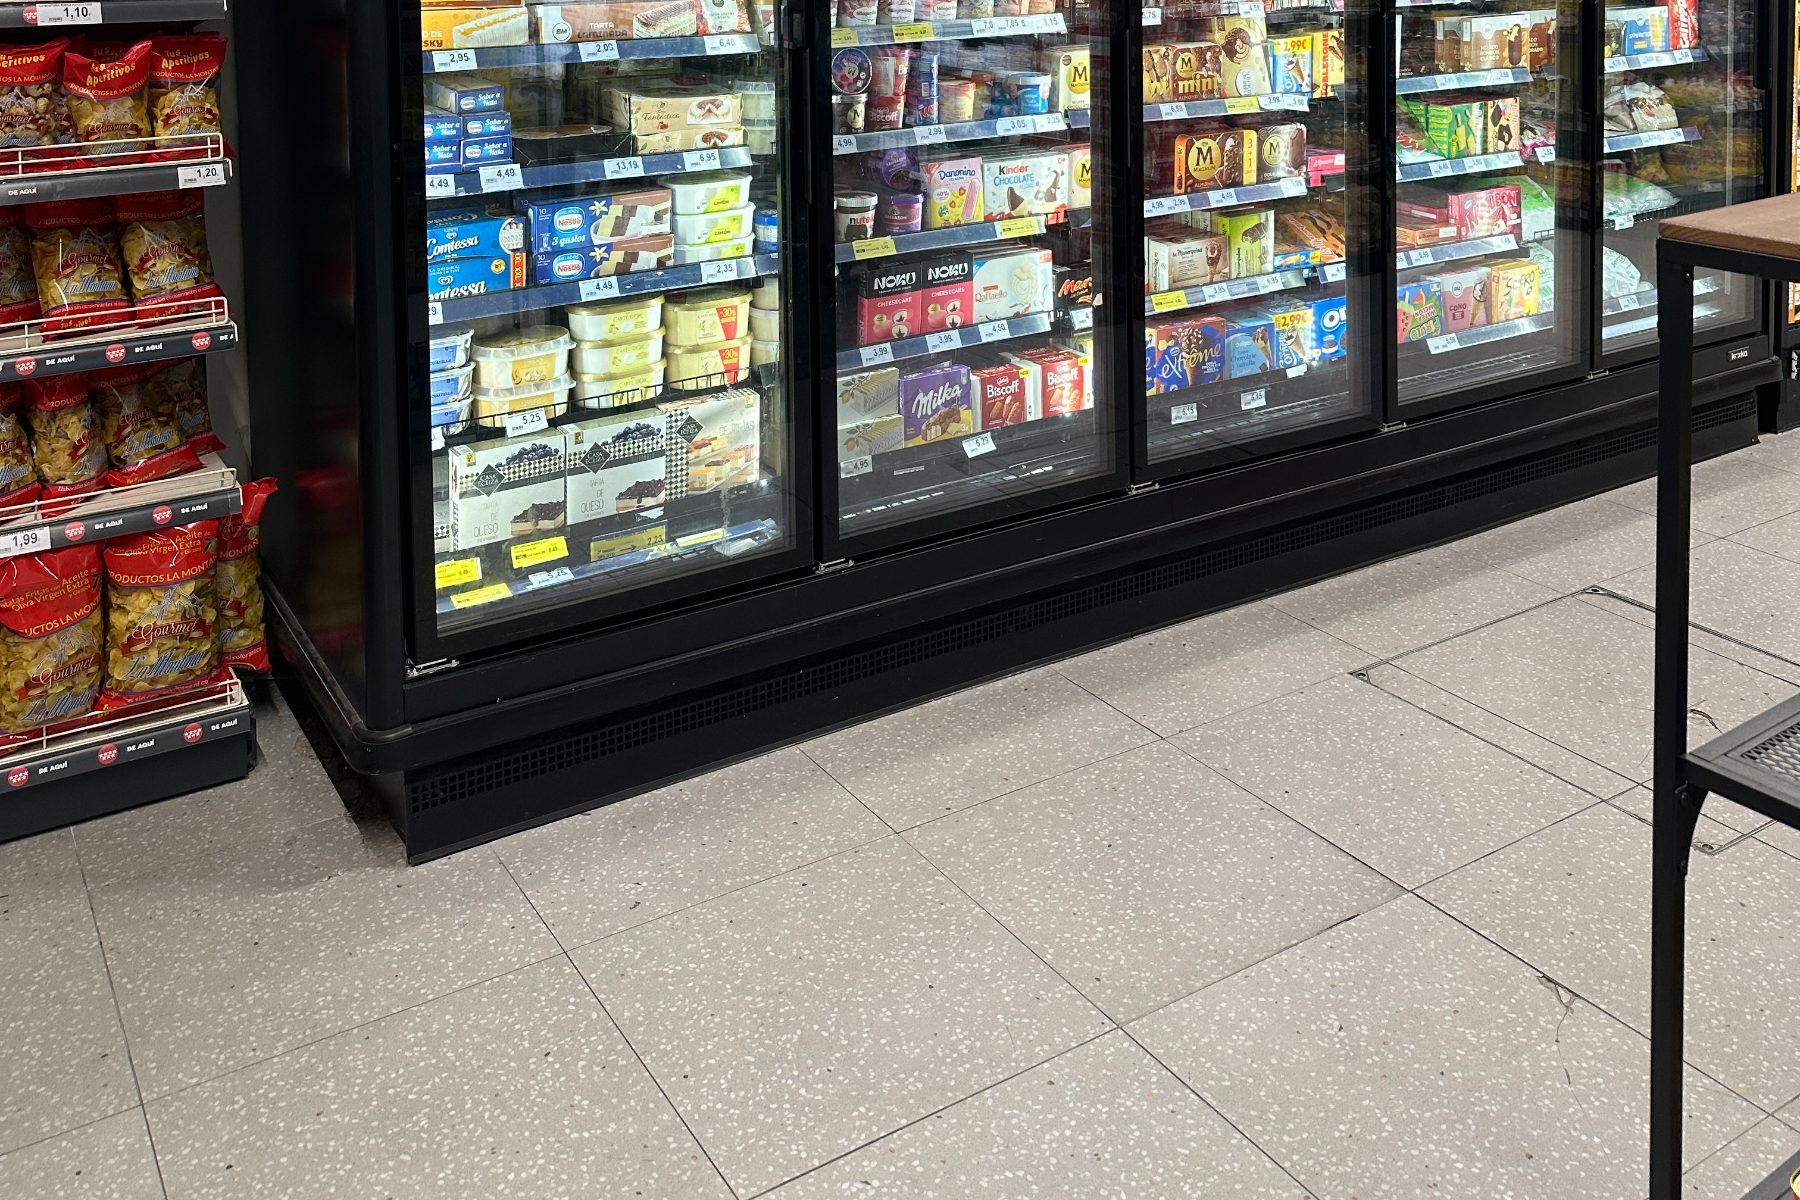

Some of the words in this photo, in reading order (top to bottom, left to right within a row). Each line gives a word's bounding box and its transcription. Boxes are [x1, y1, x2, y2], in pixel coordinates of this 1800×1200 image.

[63, 6, 89, 18] 1,10
[589, 21, 614, 29] TARTA
[161, 51, 210, 69] Aperitivos
[450, 52, 469, 62] 2,95
[1181, 57, 1192, 70] M
[86, 62, 136, 86] Aperitivos
[1072, 66, 1089, 82] M
[1178, 76, 1216, 94] mini
[869, 109, 898, 122] Biscoff
[436, 122, 454, 130] Sabor
[432, 144, 451, 152] Sabor
[484, 142, 501, 150] Sabor
[1269, 141, 1281, 154] M
[1196, 146, 1214, 167] M
[616, 161, 637, 170] 13,19
[999, 164, 1029, 176] Kinder
[1193, 164, 1216, 173] MAGNUM
[196, 167, 218, 179] 1,20
[497, 168, 515, 178] 4,49
[938, 167, 976, 181] Danonino
[994, 173, 1035, 186] CHOCOLATE
[429, 179, 449, 188] 4,49
[20, 187, 37, 195] AQUÍ
[427, 233, 479, 260] Comtessa
[551, 237, 558, 246] 3
[560, 233, 586, 247] gustos
[716, 264, 733, 274] 2,35
[928, 262, 969, 281] NOKU
[595, 280, 613, 290] 4,49
[874, 271, 916, 290] NOKU
[975, 290, 1008, 303] Raffaello
[1449, 303, 1467, 312] CONO
[146, 343, 163, 351] AQUÍ
[873, 347, 888, 357] 3,99
[57, 355, 75, 364] AQUÍ
[1047, 370, 1080, 386] Biscoff
[987, 379, 1019, 398] Biscoff
[912, 381, 963, 419] Milka
[522, 413, 541, 424] 5,25
[193, 503, 208, 512] AQUÍ
[580, 500, 605, 513] QUESO
[107, 518, 123, 528] AQUÍ
[12, 533, 38, 547] 1,99
[175, 530, 202, 543] Aceite
[179, 538, 201, 551] Extra
[166, 571, 179, 582] LA
[25, 586, 50, 599] Fritas
[62, 569, 89, 586] Aceite
[11, 597, 32, 611] Oliva
[33, 588, 65, 606] Virgen
[67, 578, 90, 593] Extra
[60, 615, 74, 627] LA
[131, 618, 198, 645] Gourmet
[30, 655, 95, 688] Gourmet
[222, 718, 238, 729] AQUÍ
[137, 738, 155, 750] AQUÍ
[38, 767, 49, 775] DE
[49, 761, 68, 773] AQUÍ
